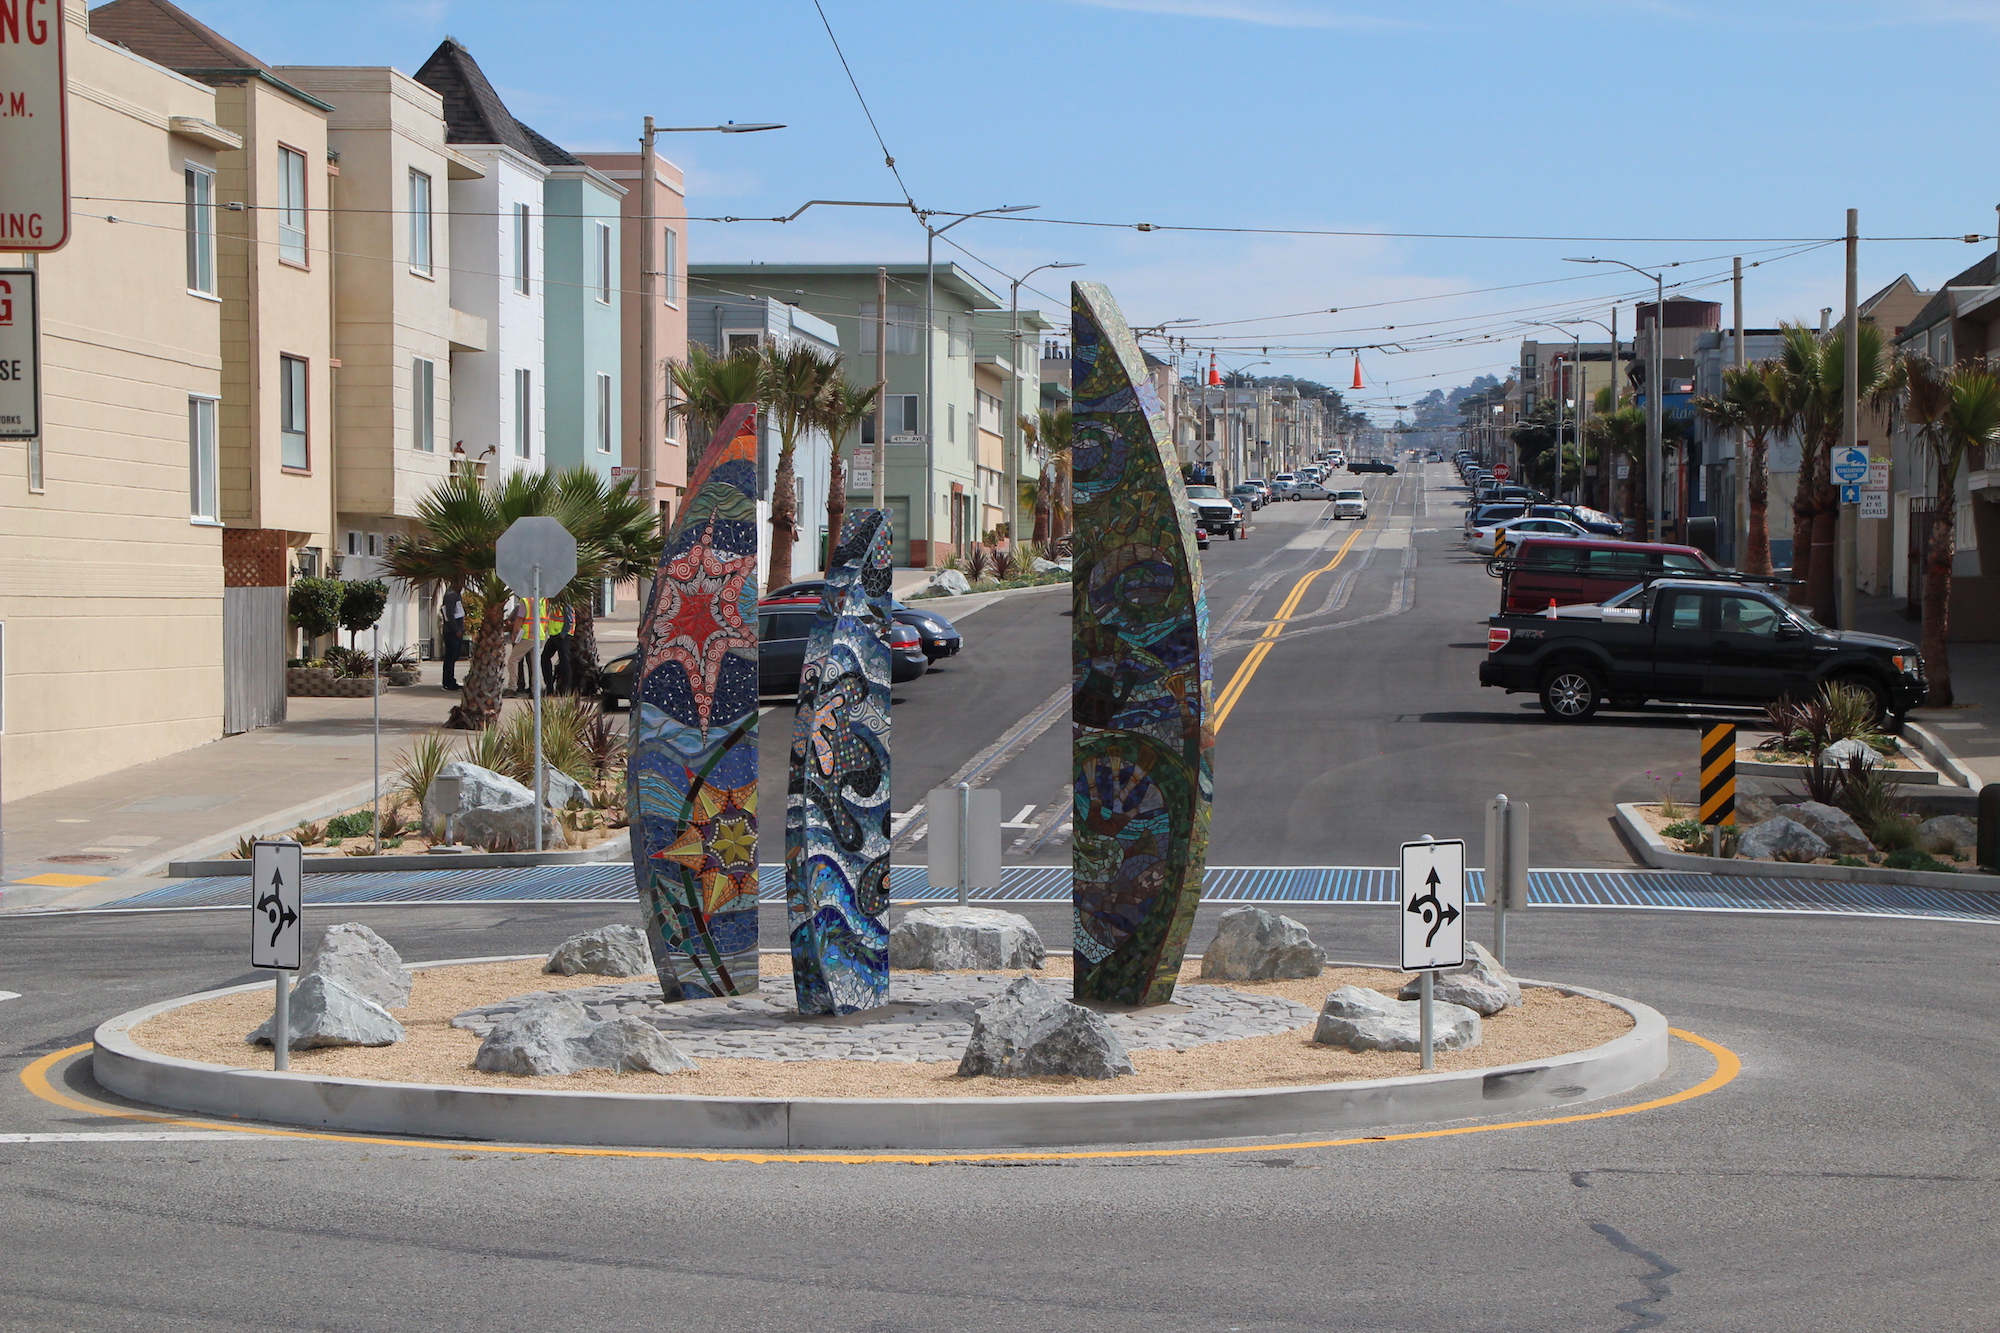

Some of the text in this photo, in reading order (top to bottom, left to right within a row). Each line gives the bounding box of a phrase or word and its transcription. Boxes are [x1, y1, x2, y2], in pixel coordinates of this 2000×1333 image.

[1, 213, 43, 239] ING
[0, 360, 21, 381] SE
[0, 416, 21, 425] ORKS
